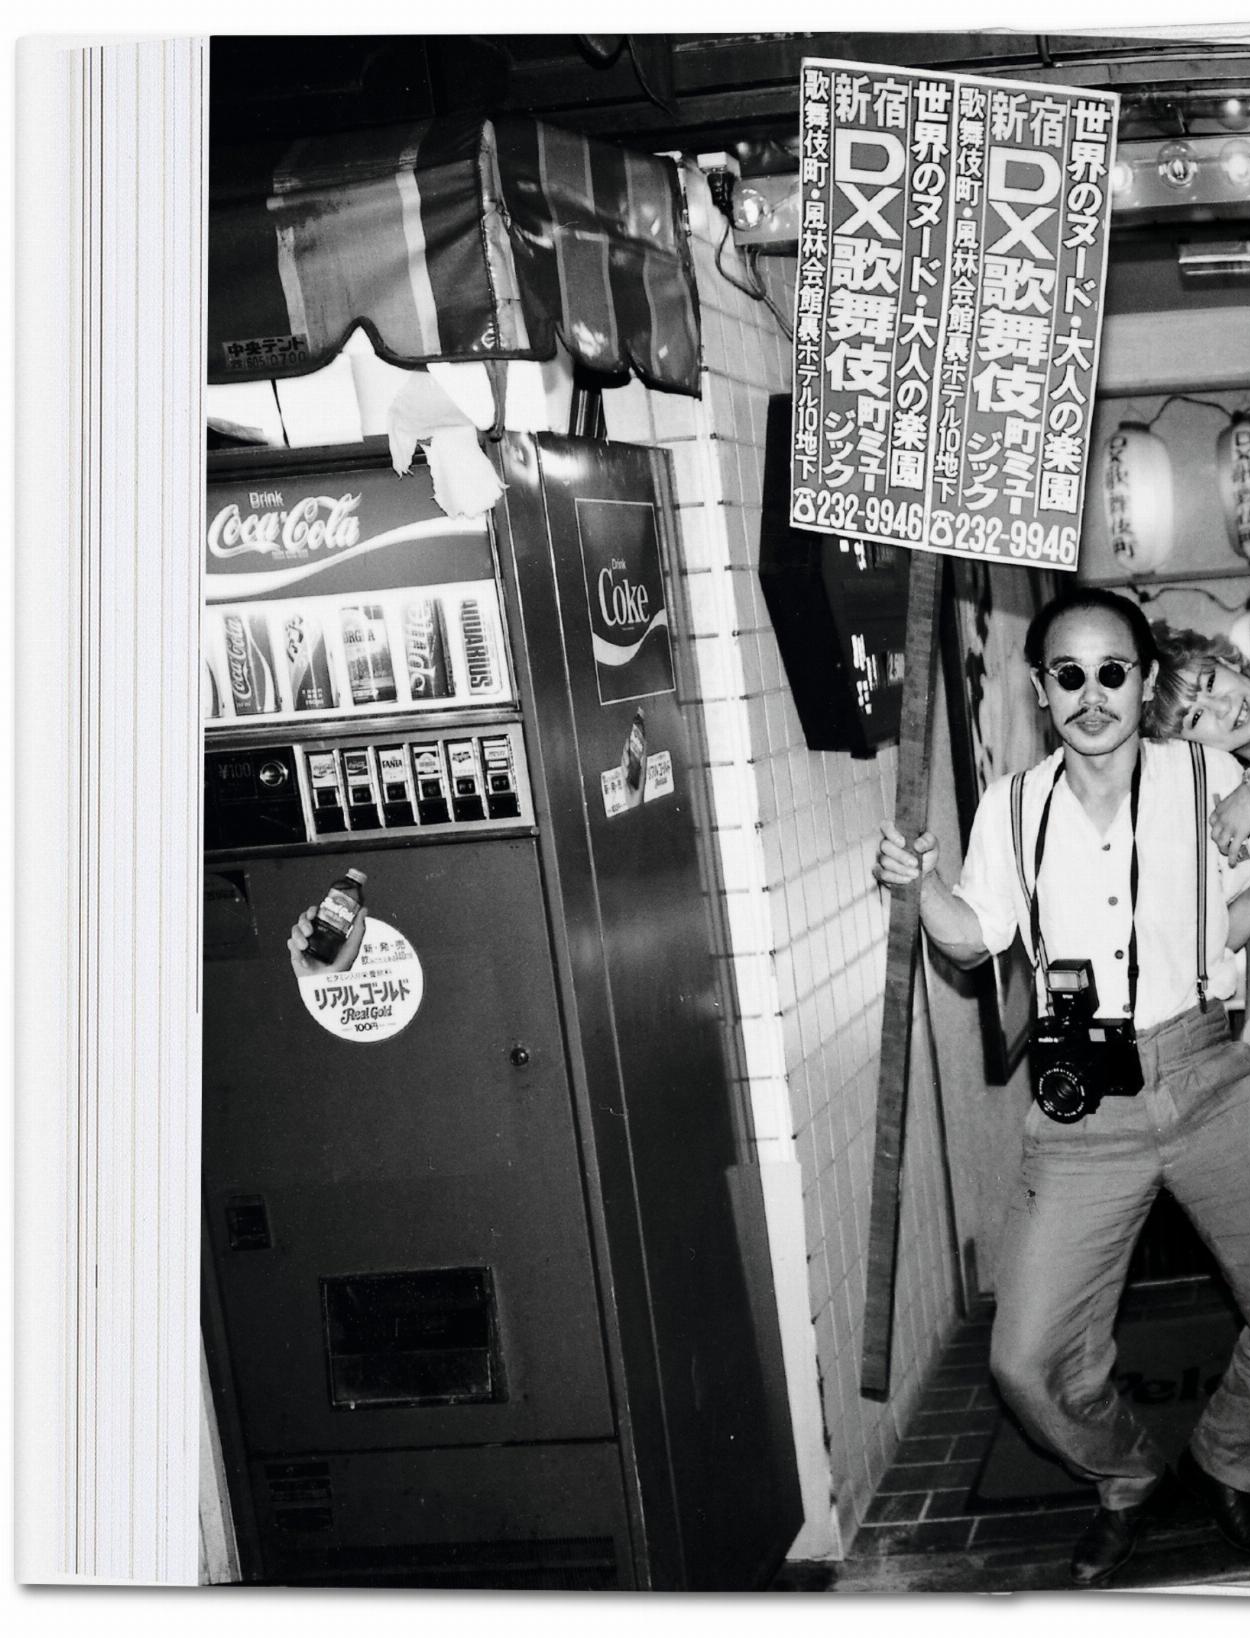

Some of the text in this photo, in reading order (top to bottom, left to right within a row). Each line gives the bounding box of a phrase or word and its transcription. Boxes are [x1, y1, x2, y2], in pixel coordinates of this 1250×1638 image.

[834, 71, 909, 130] 新宿
[990, 91, 1068, 148] 新宿
[889, 80, 951, 490] 世界のヌード・大人の楽園
[1039, 101, 1111, 515] 世界のヌード・大人の楽園
[227, 336, 305, 358] 中央テント
[250, 491, 285, 509] Drink
[816, 490, 923, 541] 232-9946
[955, 513, 1077, 565] 232-9946
[598, 567, 650, 627] Coke
[340, 1004, 393, 1025] Real Gold
